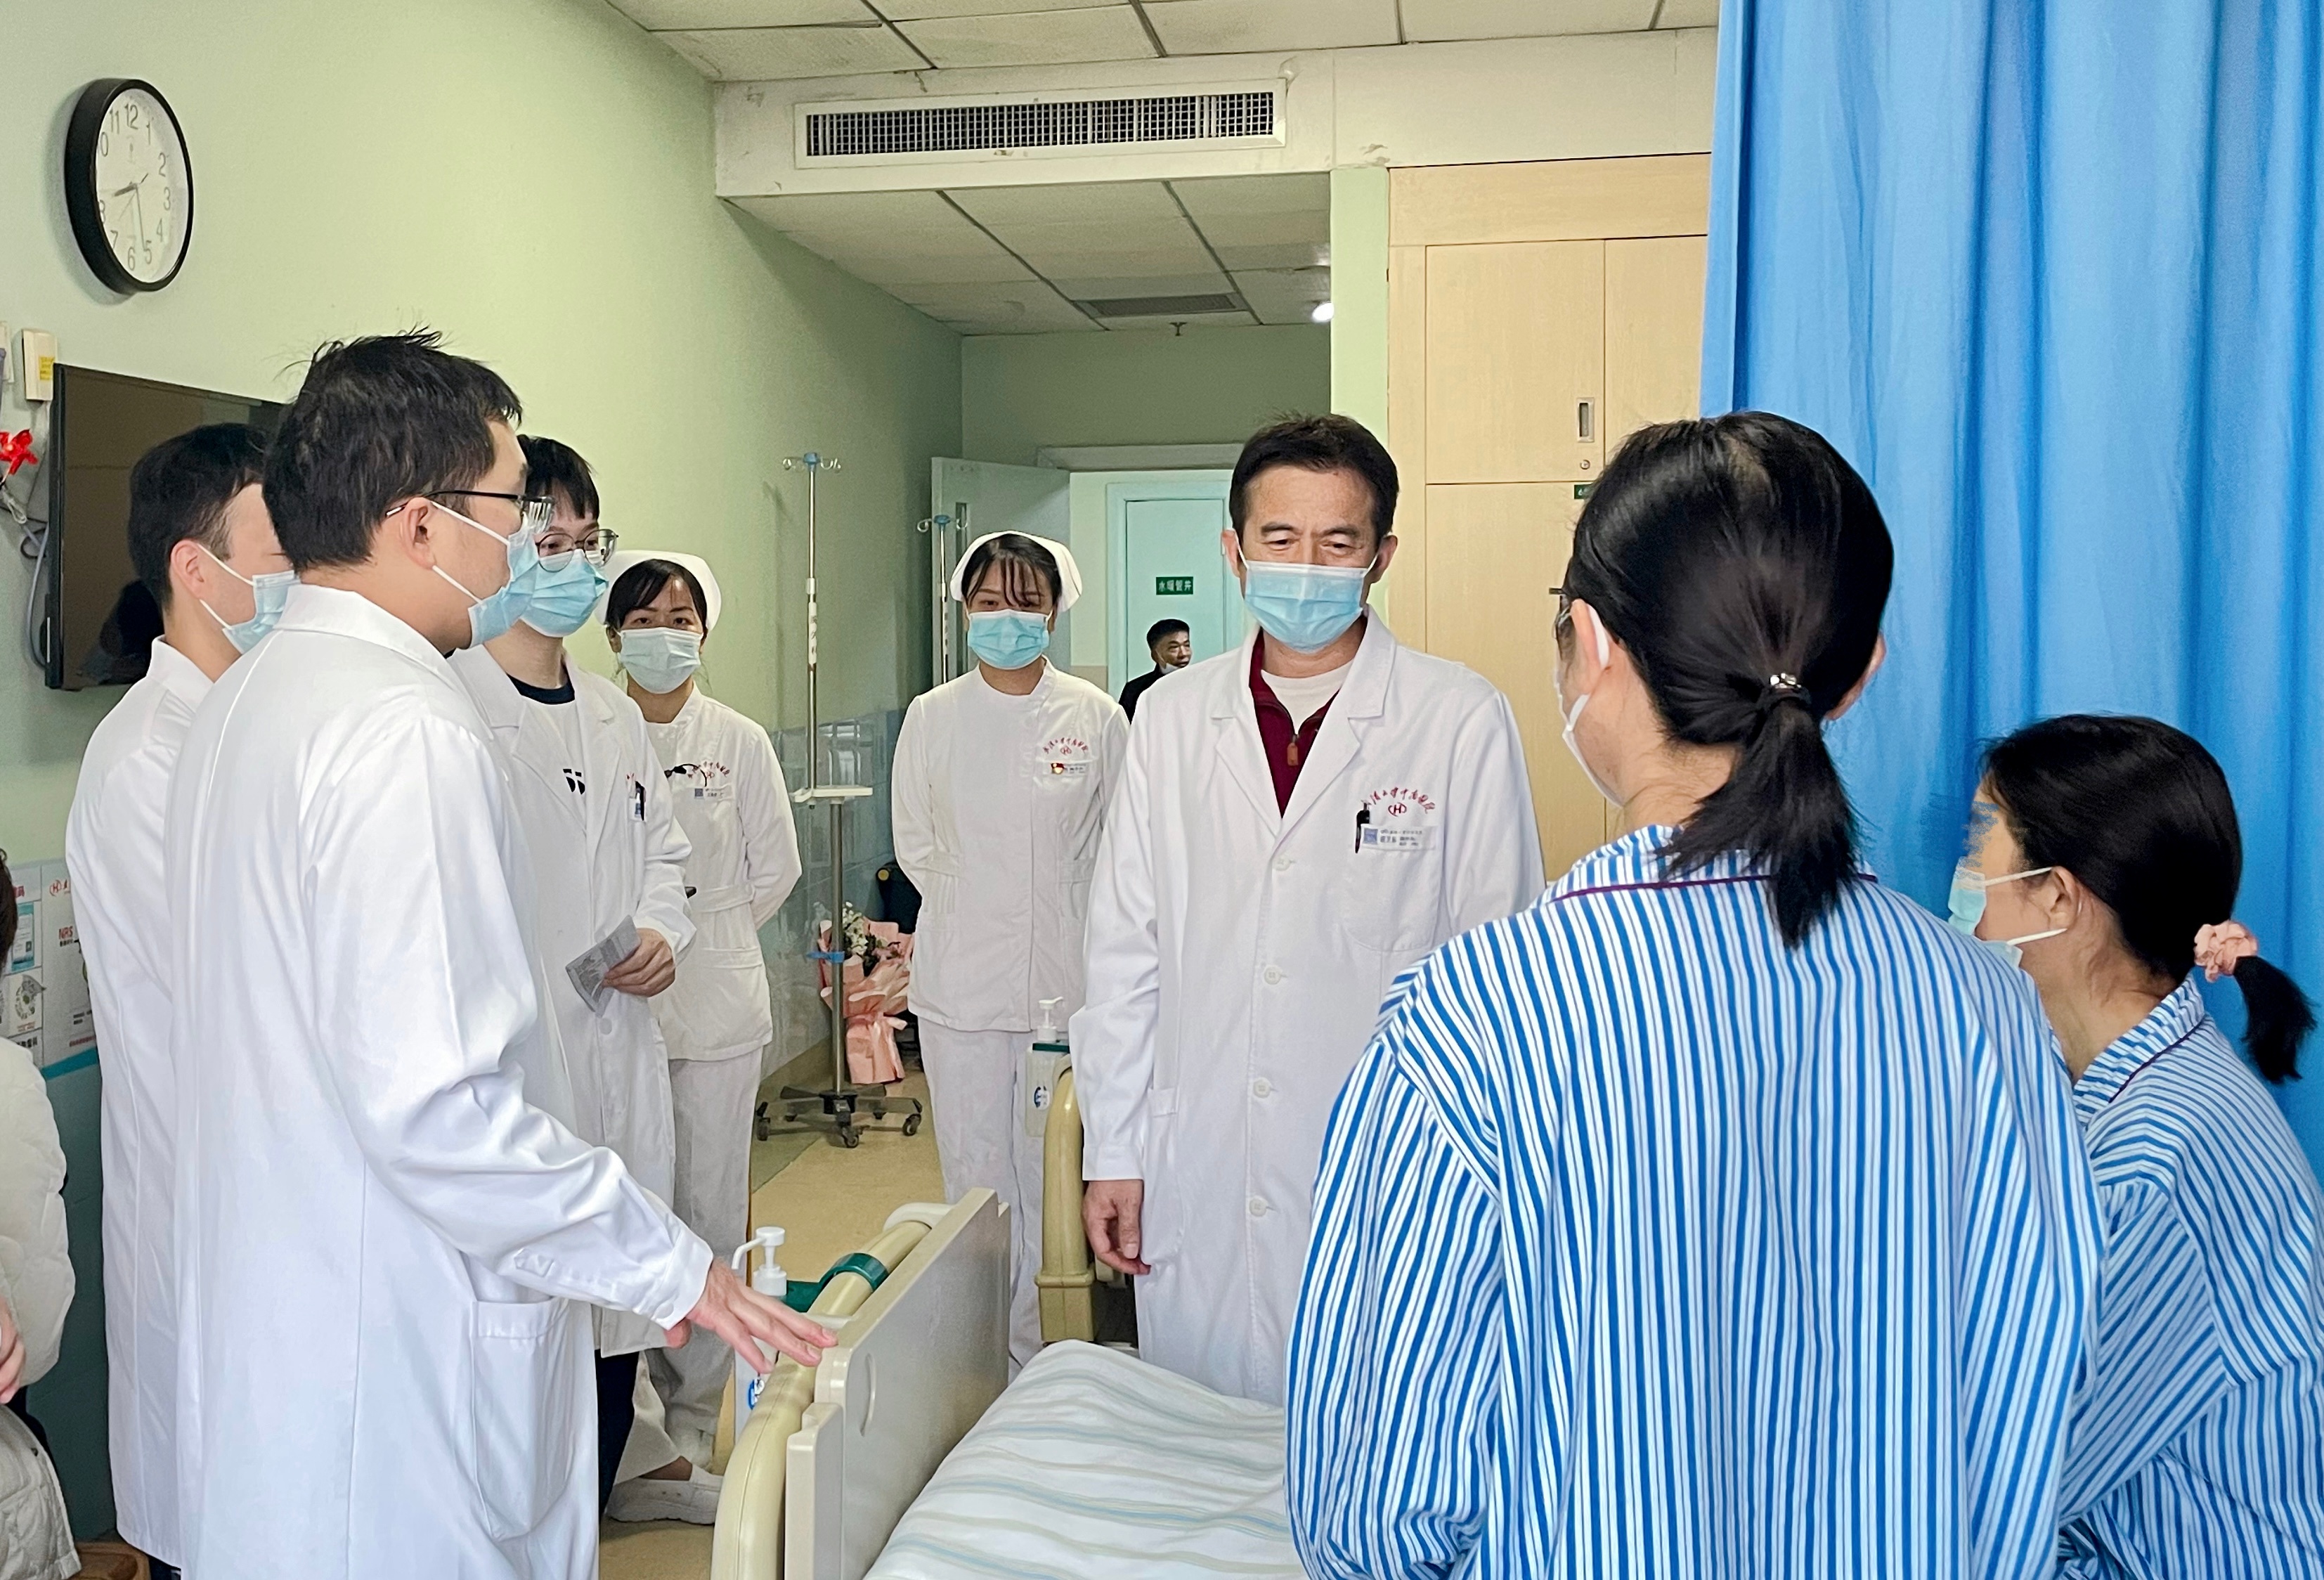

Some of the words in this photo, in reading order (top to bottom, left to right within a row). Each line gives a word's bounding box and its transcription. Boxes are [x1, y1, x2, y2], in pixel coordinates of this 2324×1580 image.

[110, 108, 120, 134] 11
[124, 103, 138, 129] 12
[145, 121, 151, 145] 1
[158, 152, 167, 177] 2
[163, 186, 171, 211] 3
[110, 230, 119, 248] 7
[156, 218, 163, 242] 4
[127, 246, 136, 271] 6
[143, 240, 152, 264] 5
